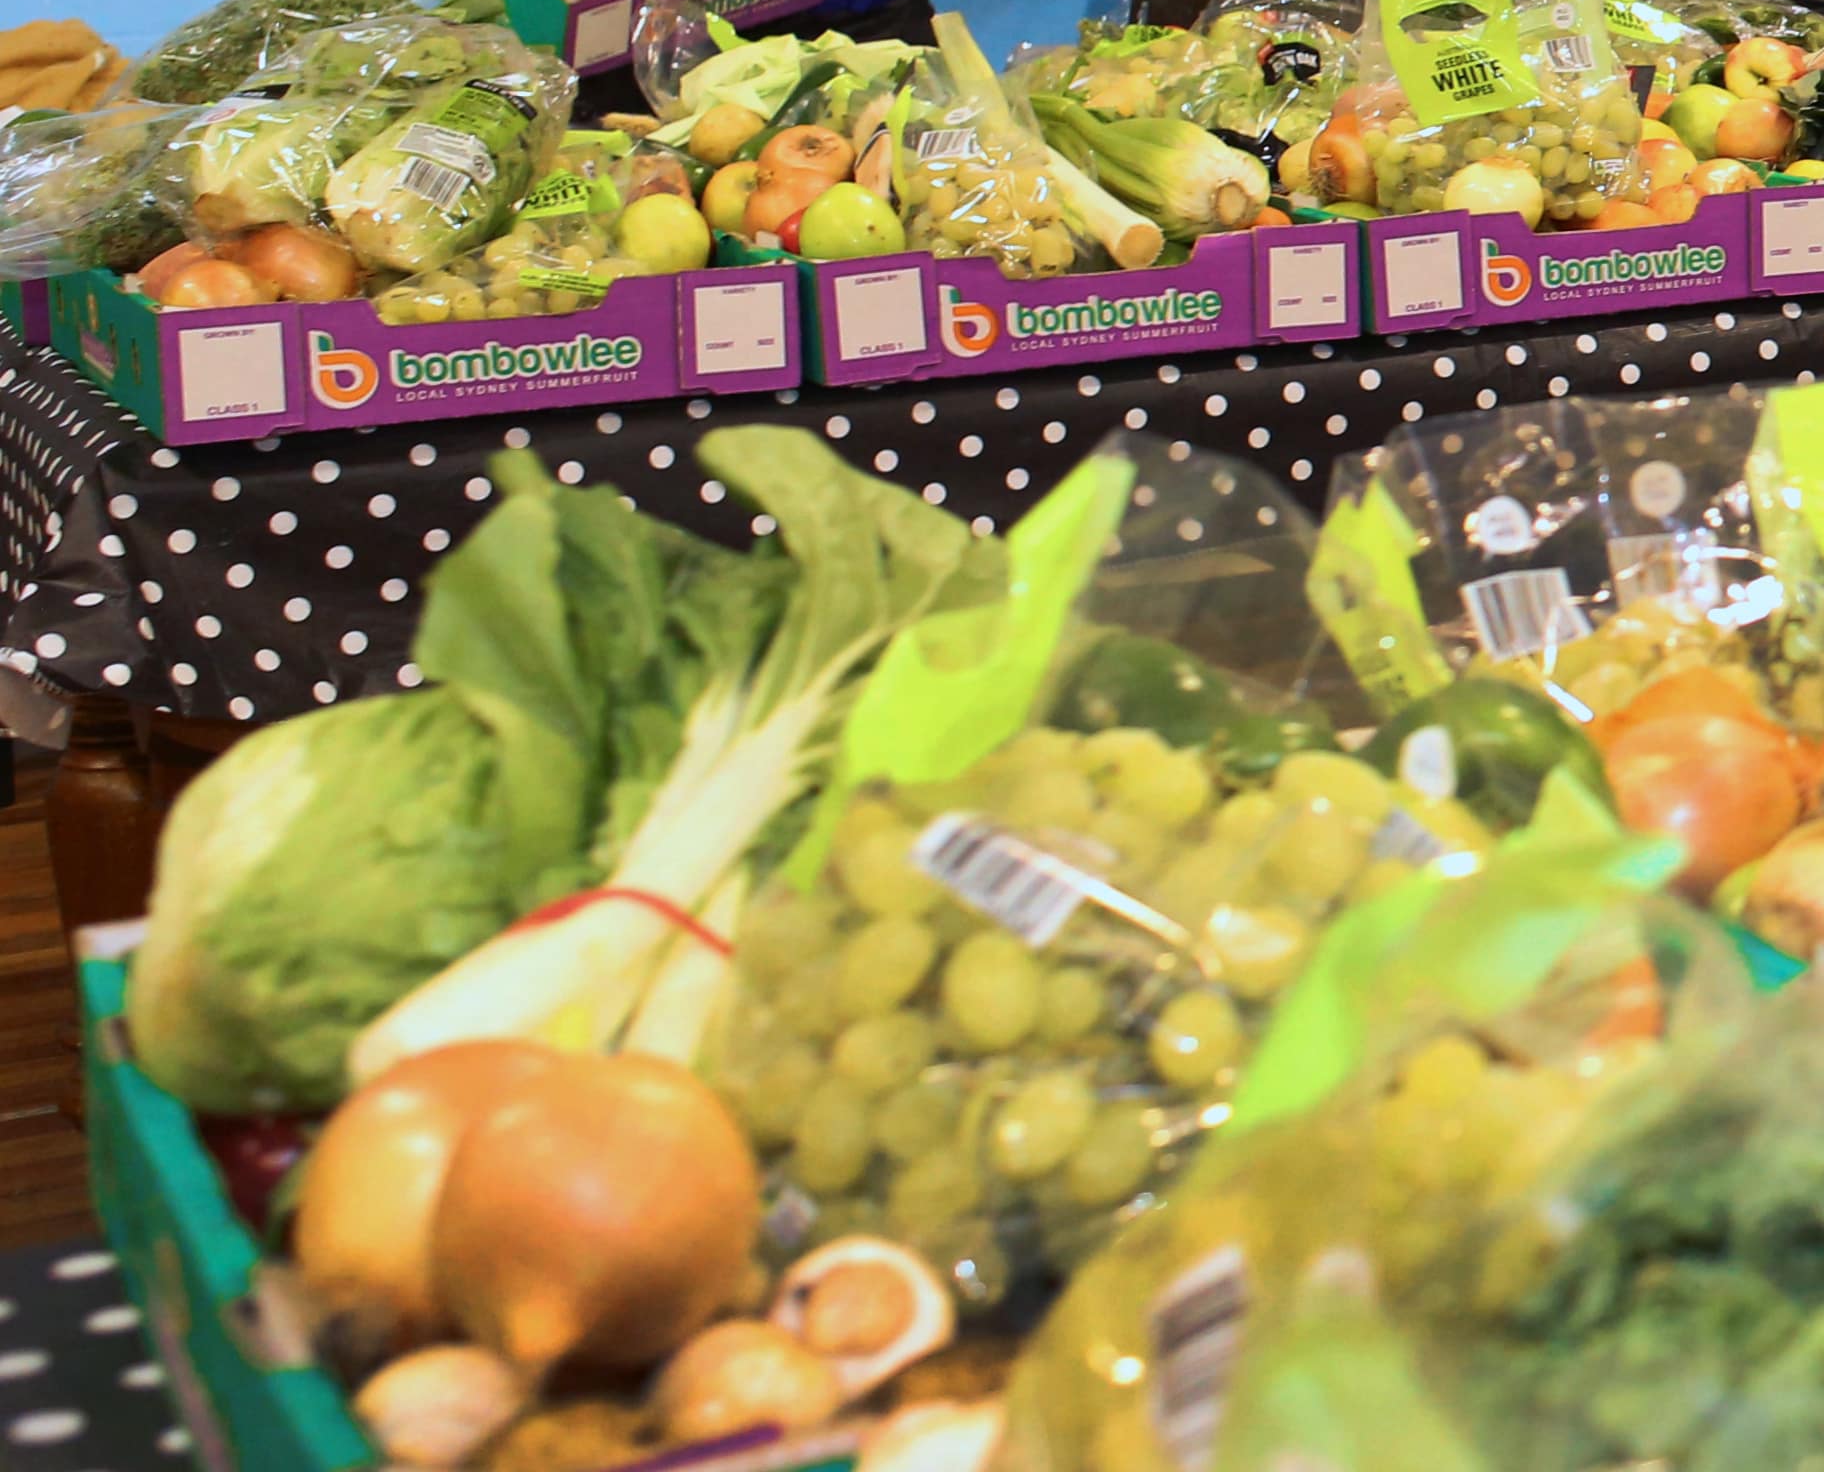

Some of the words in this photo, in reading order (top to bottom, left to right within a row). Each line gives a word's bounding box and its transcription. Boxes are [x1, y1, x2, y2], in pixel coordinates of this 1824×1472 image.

[1432, 59, 1505, 92] WHITE
[1452, 83, 1495, 101] GRAPES
[1539, 243, 1727, 289] bombowlee
[1543, 288, 1582, 301] LOCAL
[1588, 284, 1634, 298] SYDNEY
[1639, 276, 1725, 293] SUMMERFRUIT
[1006, 288, 1222, 337] bombowlee
[860, 343, 896, 355] CLASS
[1011, 338, 1055, 352] LOCAL
[1062, 332, 1115, 347] SYDNEY
[1122, 323, 1218, 341] SUMMERFRUIT
[390, 333, 642, 387] bombowlee
[395, 389, 448, 403] LOCAL
[455, 382, 518, 397] SYDNEY
[526, 371, 638, 390] SUMMERFRUIT
[207, 403, 249, 416] CLASS
[251, 403, 259, 412] 1
